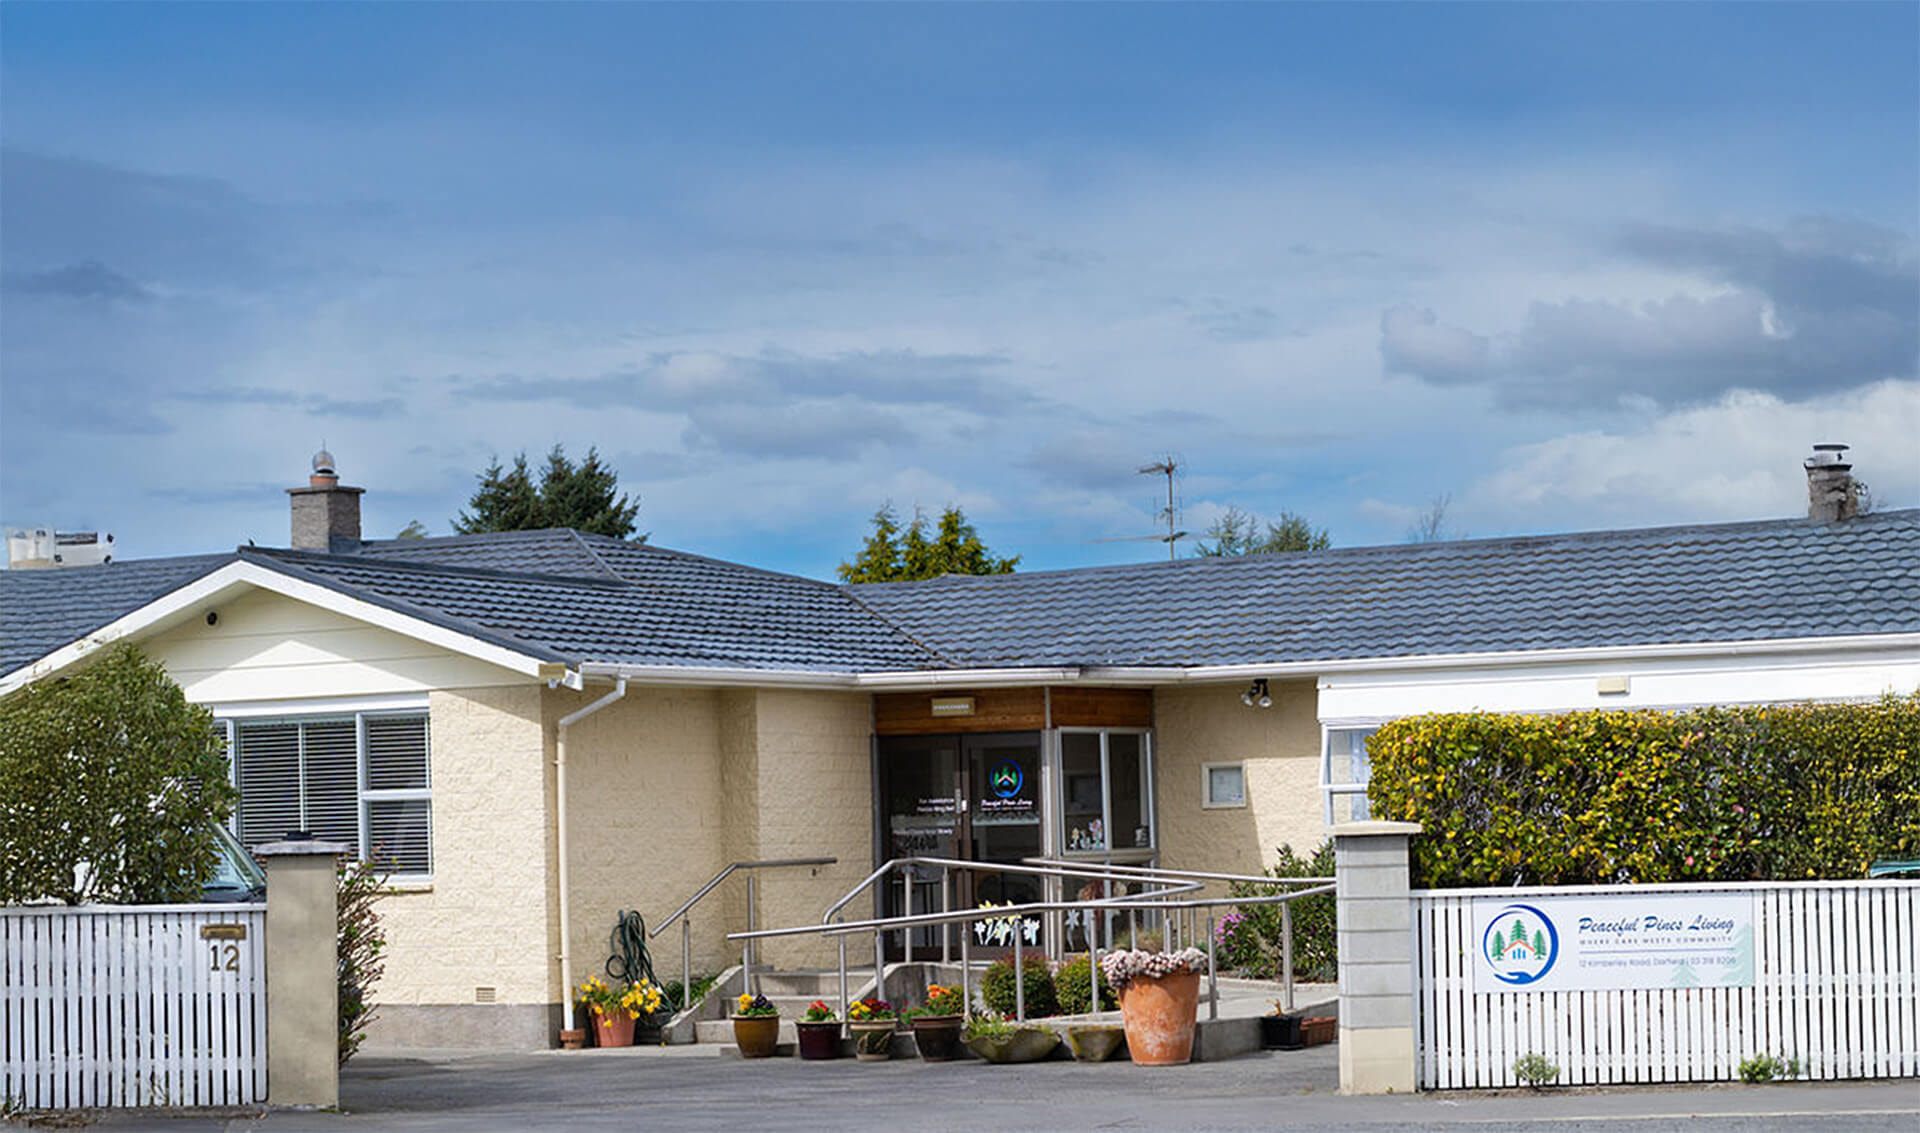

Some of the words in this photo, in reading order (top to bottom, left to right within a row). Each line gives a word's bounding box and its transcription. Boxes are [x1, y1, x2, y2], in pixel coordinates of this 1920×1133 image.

[1578, 917, 1640, 937] Peaceful
[1643, 915, 1683, 932] Pines
[1686, 914, 1735, 934] Living
[1676, 935, 1732, 943] COMMUNITY
[210, 944, 240, 972] 12
